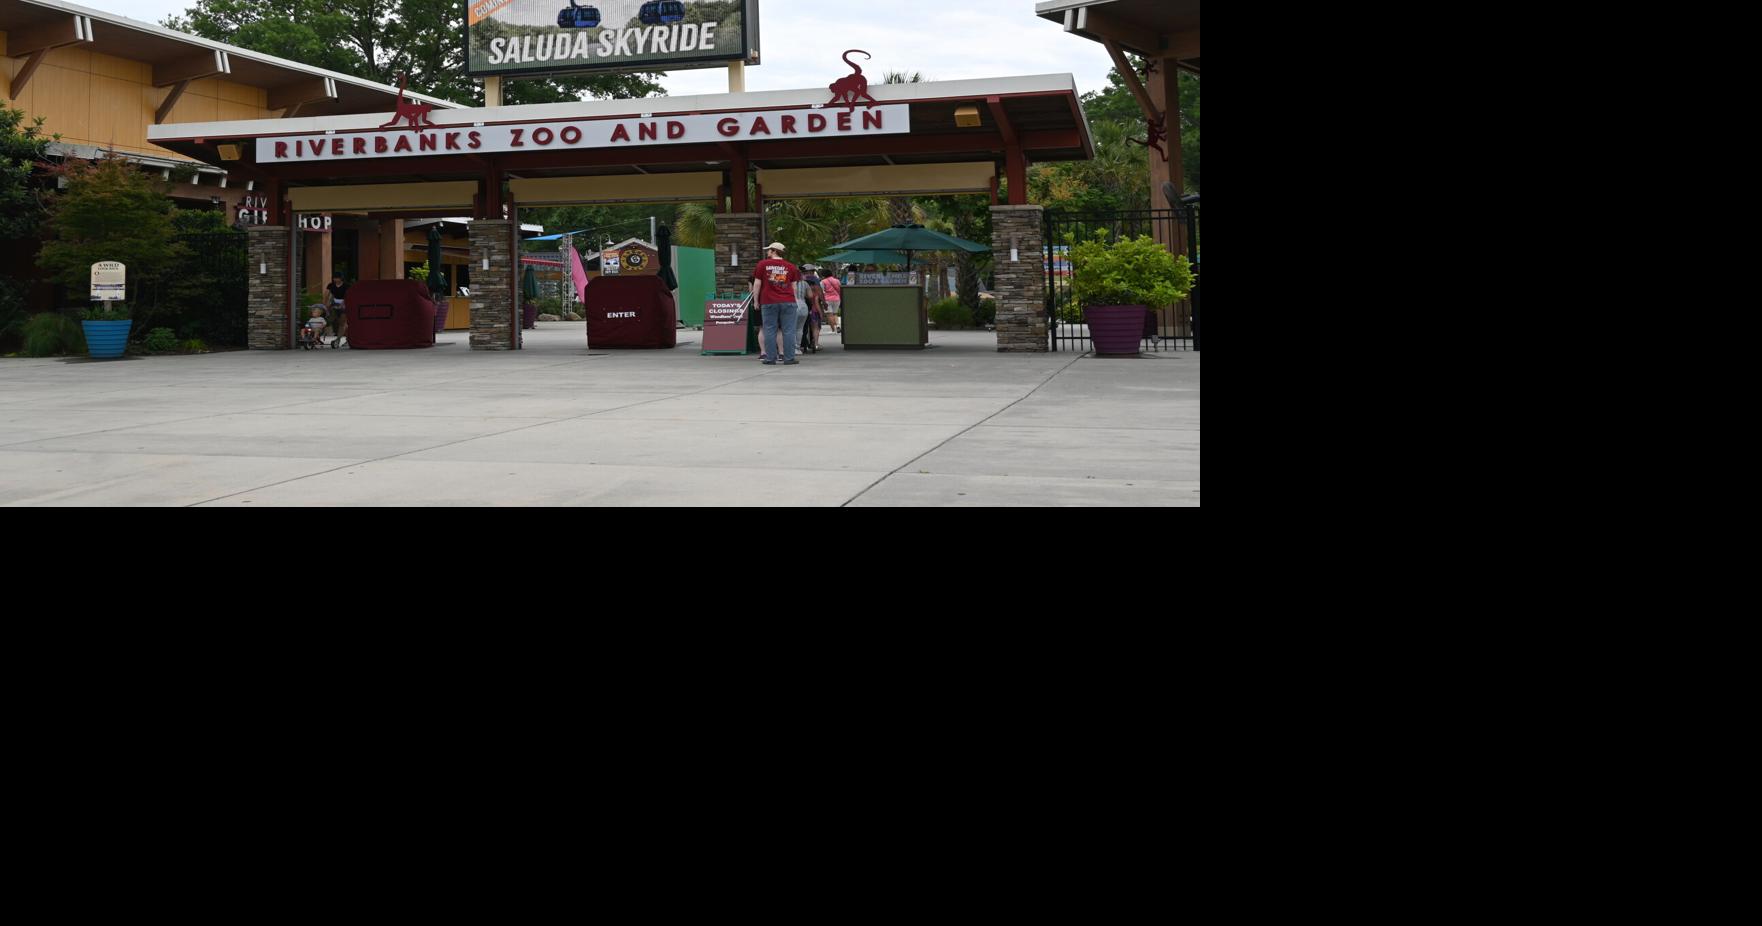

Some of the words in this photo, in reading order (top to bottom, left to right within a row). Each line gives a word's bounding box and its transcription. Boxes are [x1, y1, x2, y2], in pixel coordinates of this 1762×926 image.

[488, 32, 589, 65] SALUDA
[596, 21, 718, 57] SKYRIDE
[274, 131, 482, 158] RIVERBANKS
[509, 125, 583, 147] ZOO
[610, 120, 686, 143] AND
[717, 109, 883, 137] GARDEN
[607, 311, 636, 319] ENTER
